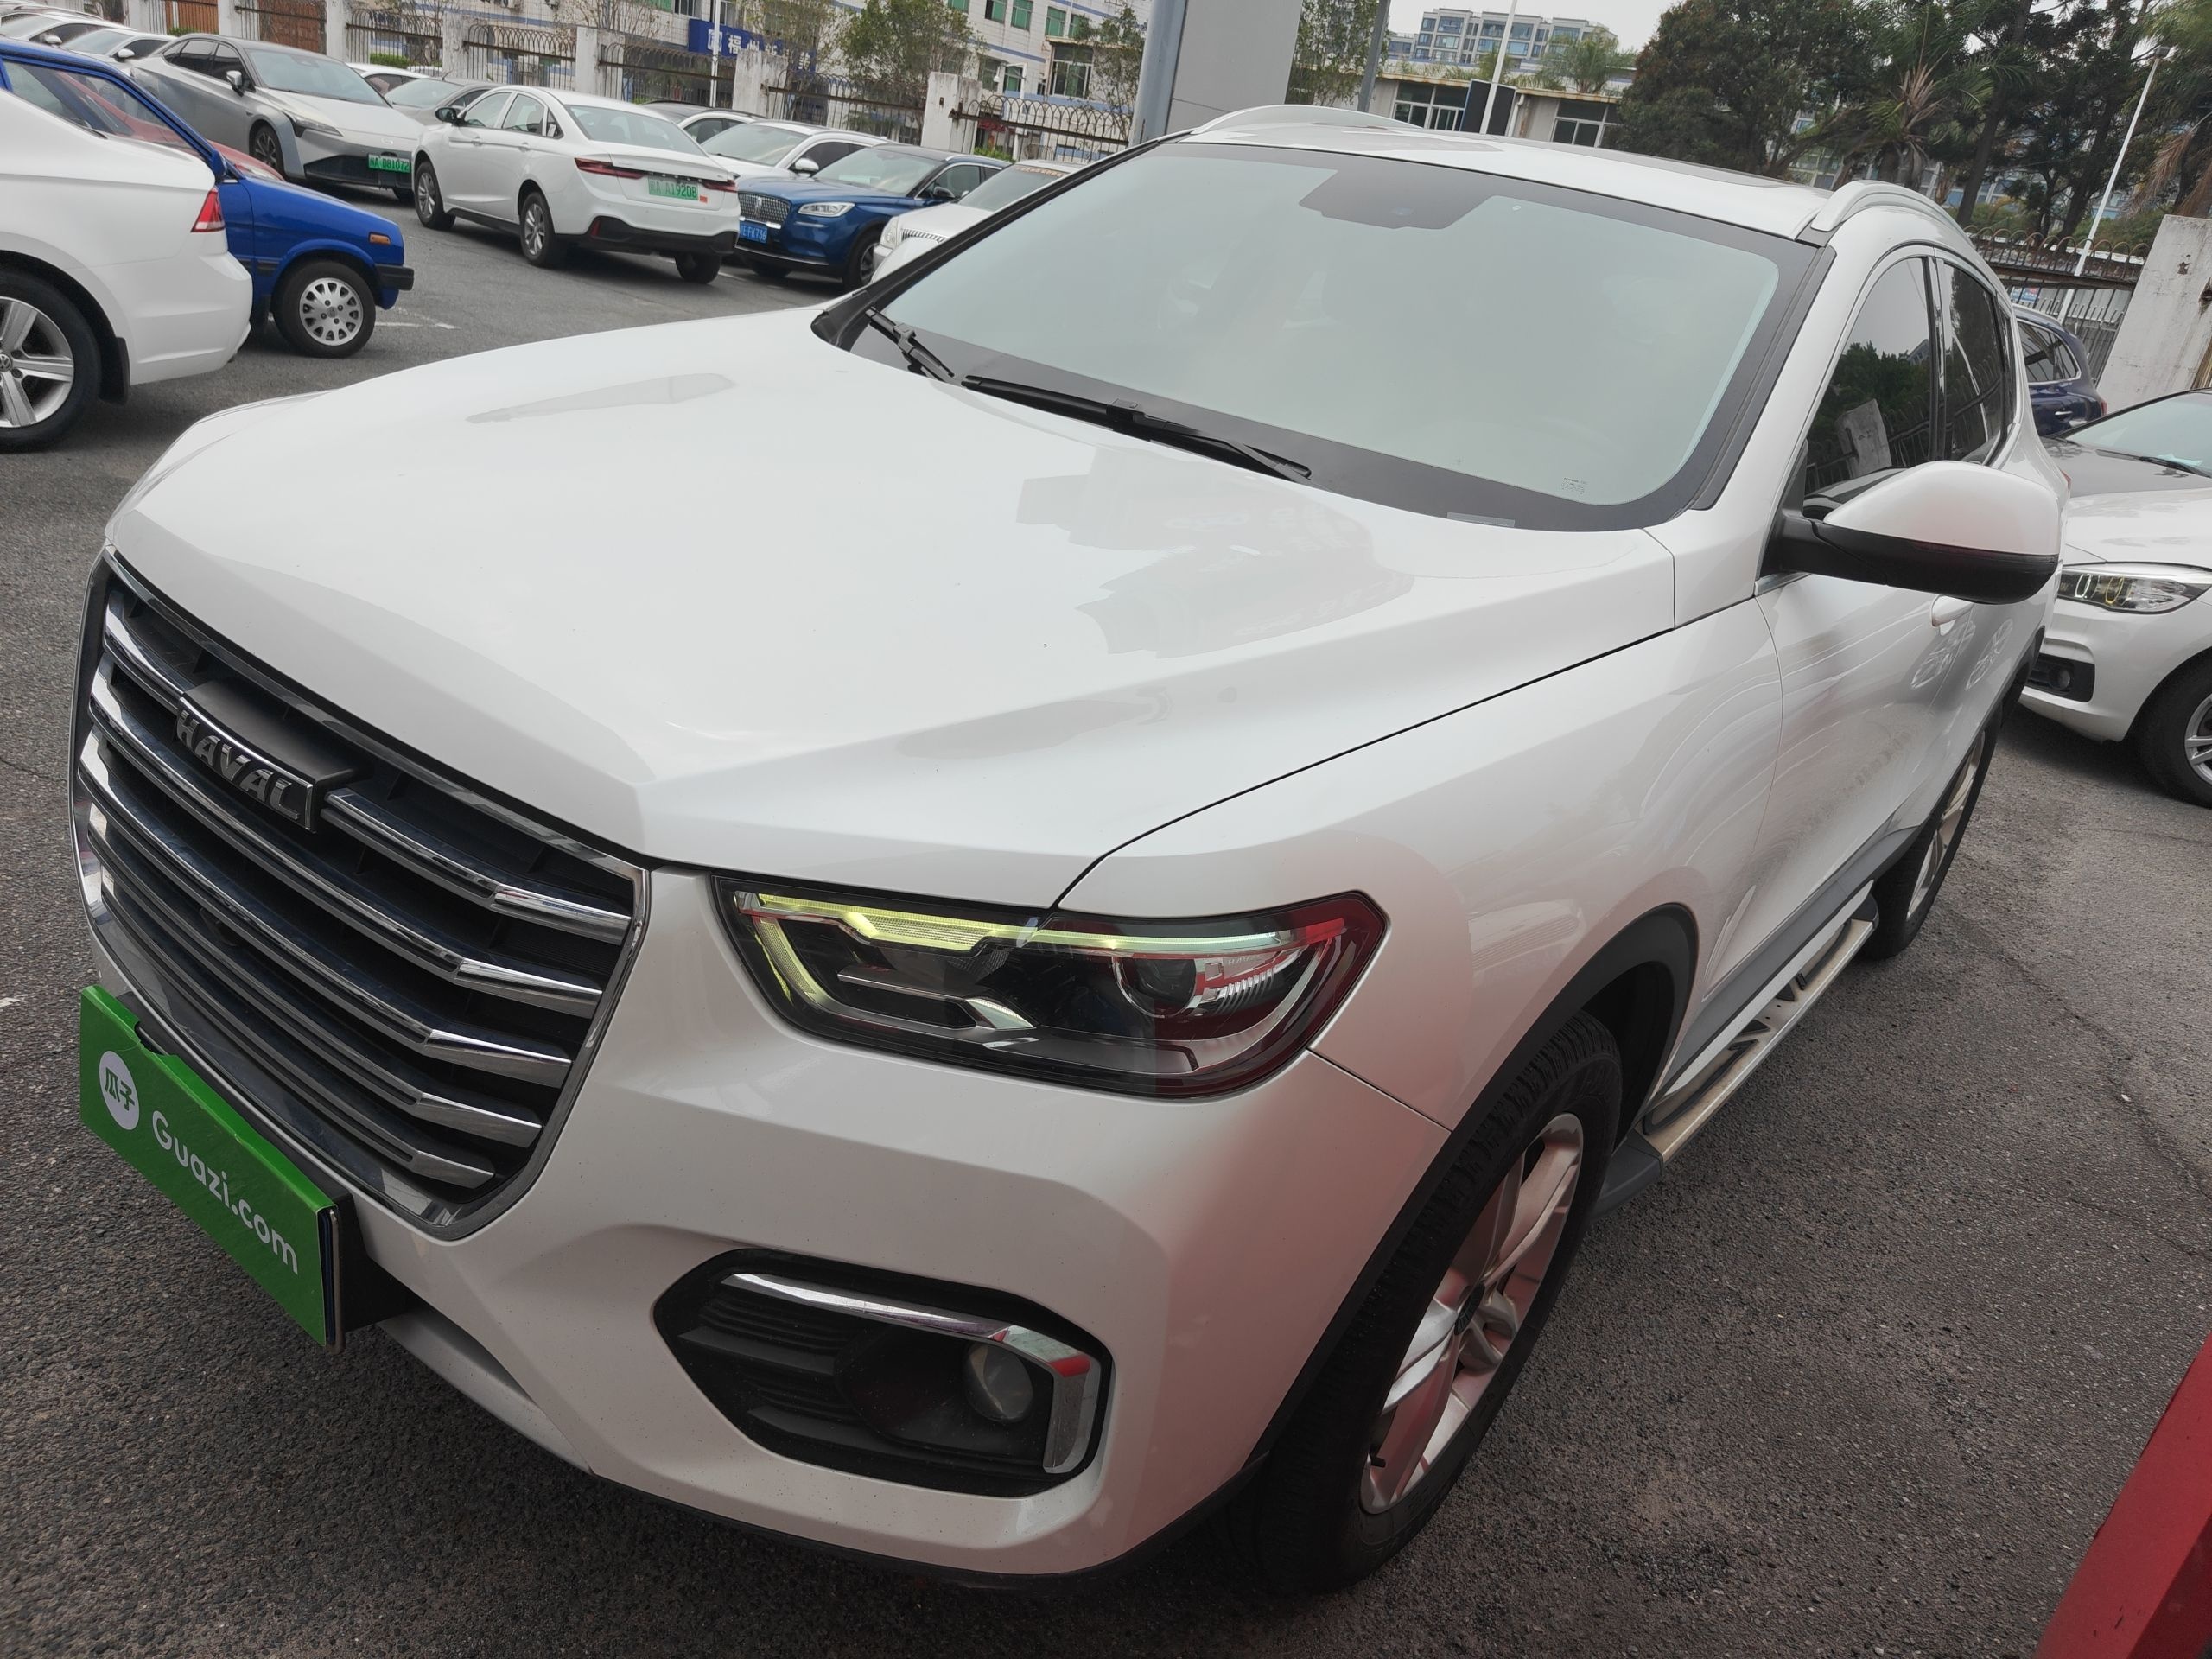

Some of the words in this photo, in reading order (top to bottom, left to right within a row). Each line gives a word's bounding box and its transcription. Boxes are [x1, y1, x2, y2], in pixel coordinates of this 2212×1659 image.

[176, 709, 301, 821] HAVAL
[104, 1066, 136, 1112] 瓜子
[151, 1109, 299, 1275] Guazi.com
